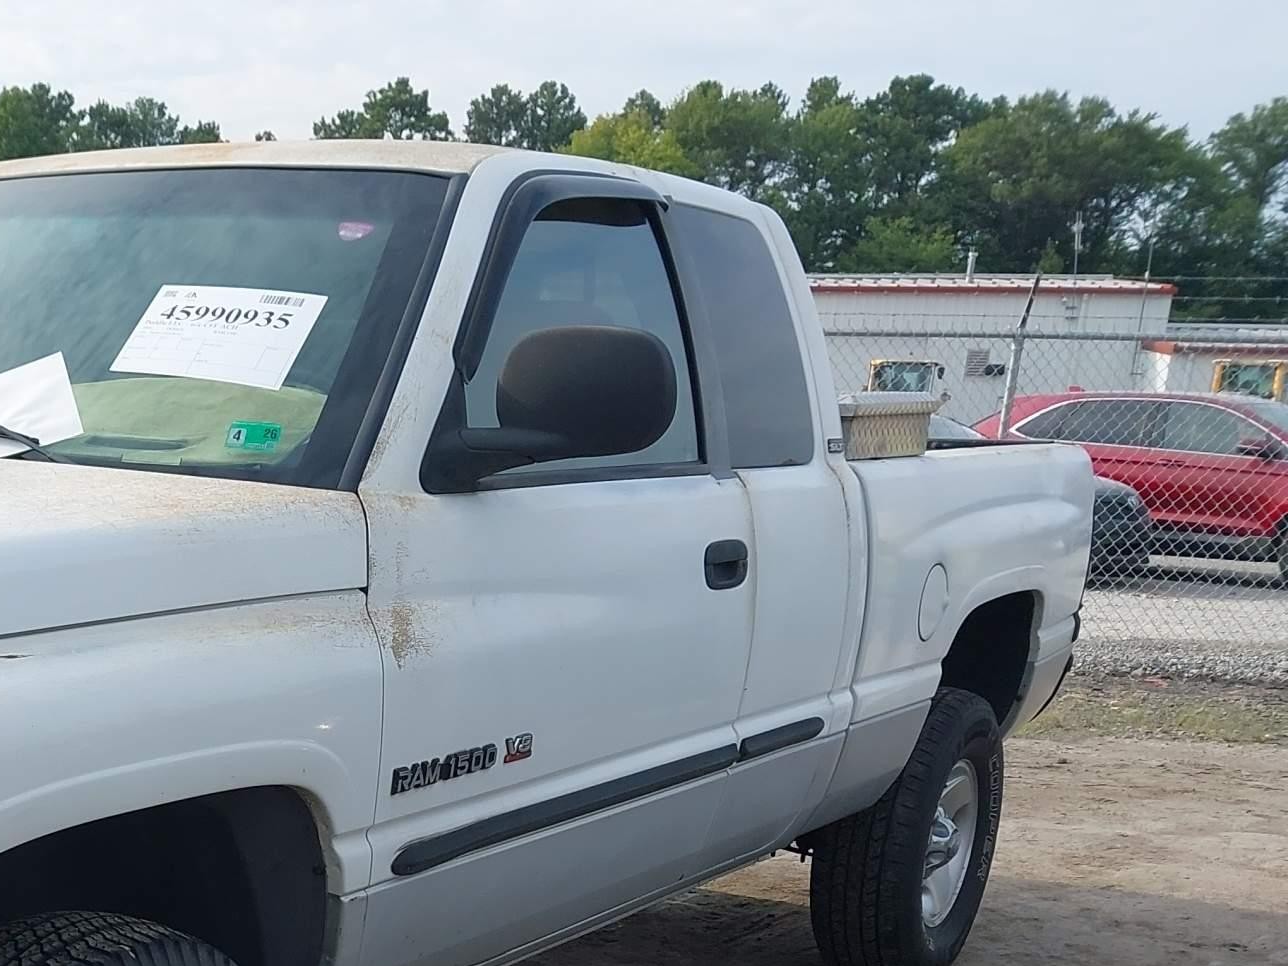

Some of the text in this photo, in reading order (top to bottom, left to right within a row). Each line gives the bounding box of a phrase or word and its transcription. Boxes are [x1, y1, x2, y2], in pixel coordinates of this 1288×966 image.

[160, 304, 294, 330] 45990935
[232, 428, 278, 441] 4 26
[392, 732, 533, 795] RAM 1500 V8
